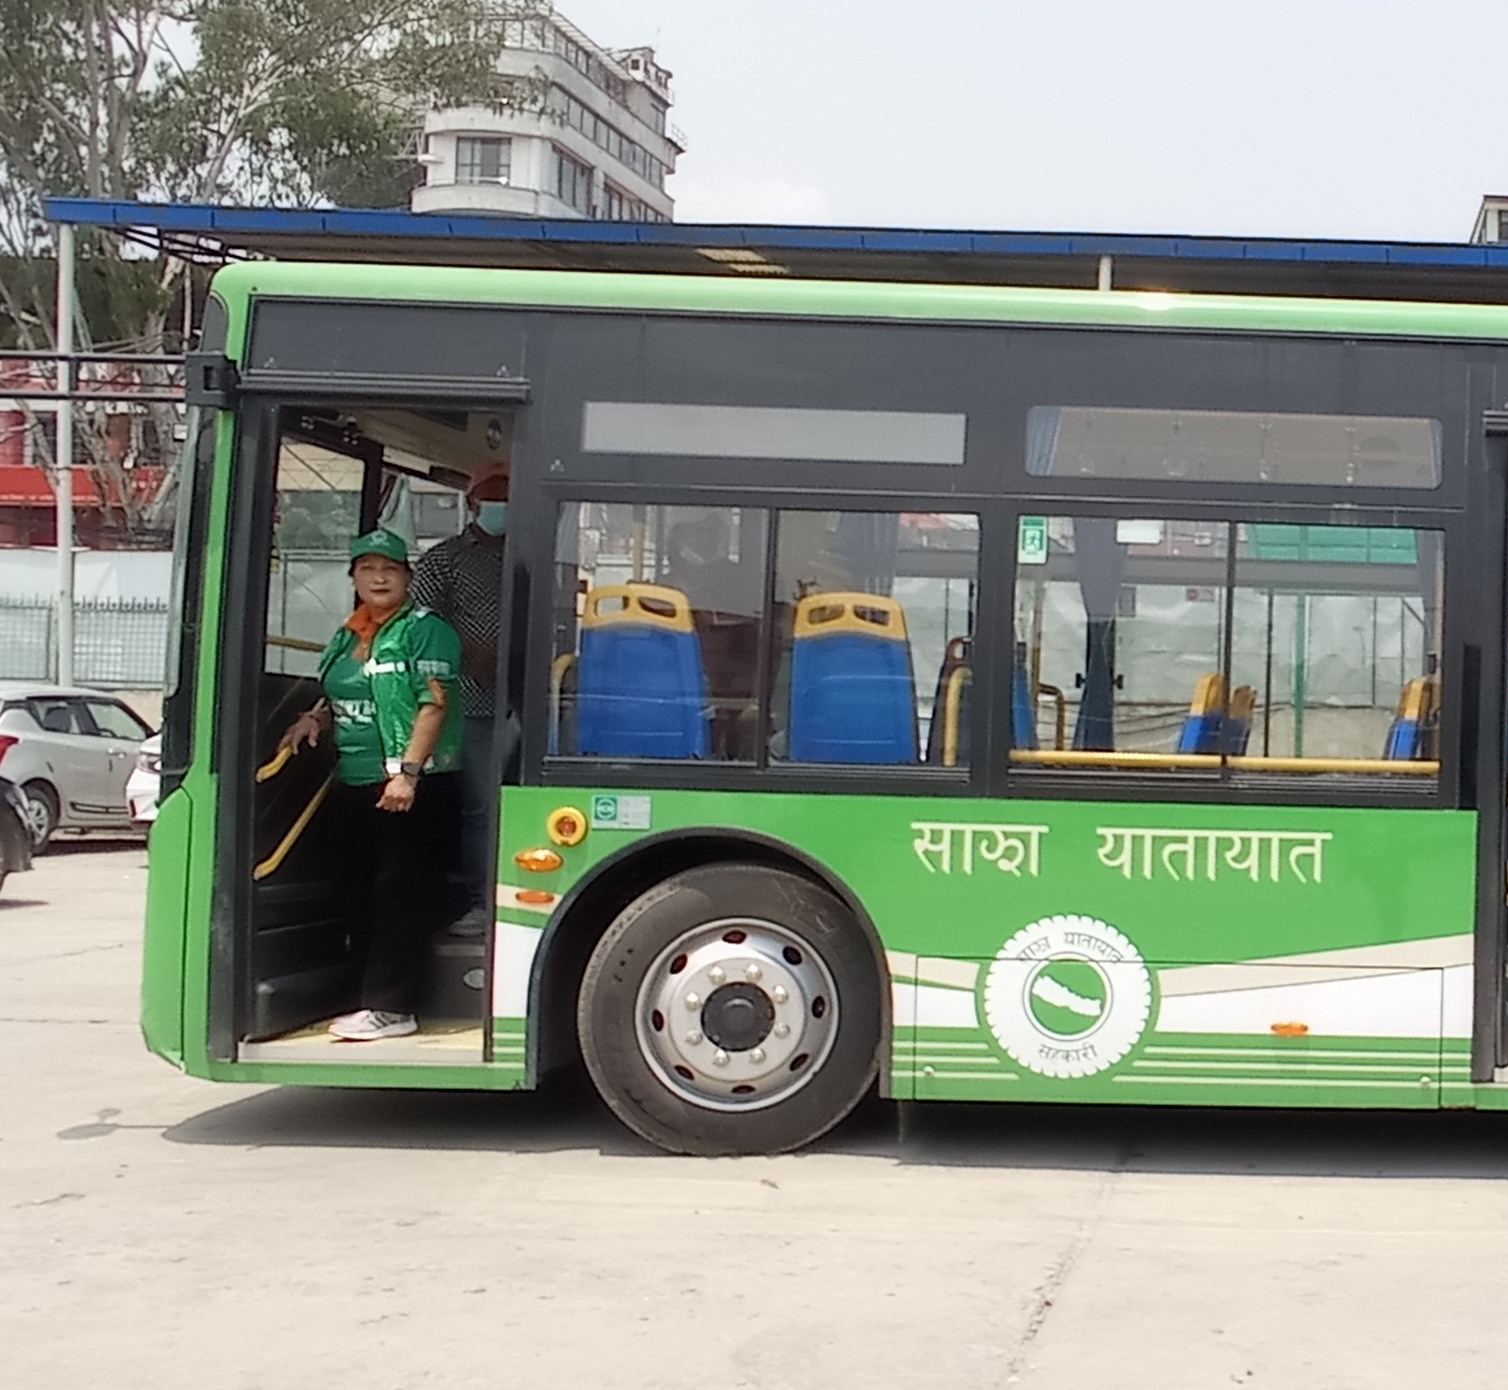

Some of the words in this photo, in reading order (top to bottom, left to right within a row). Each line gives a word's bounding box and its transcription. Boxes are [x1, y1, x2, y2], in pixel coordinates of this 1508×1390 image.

[911, 821, 1050, 878] साझा
[1096, 826, 1333, 884] यातायात
[1063, 931, 1125, 963] यातायात
[1038, 1041, 1098, 1064] सहकारी
